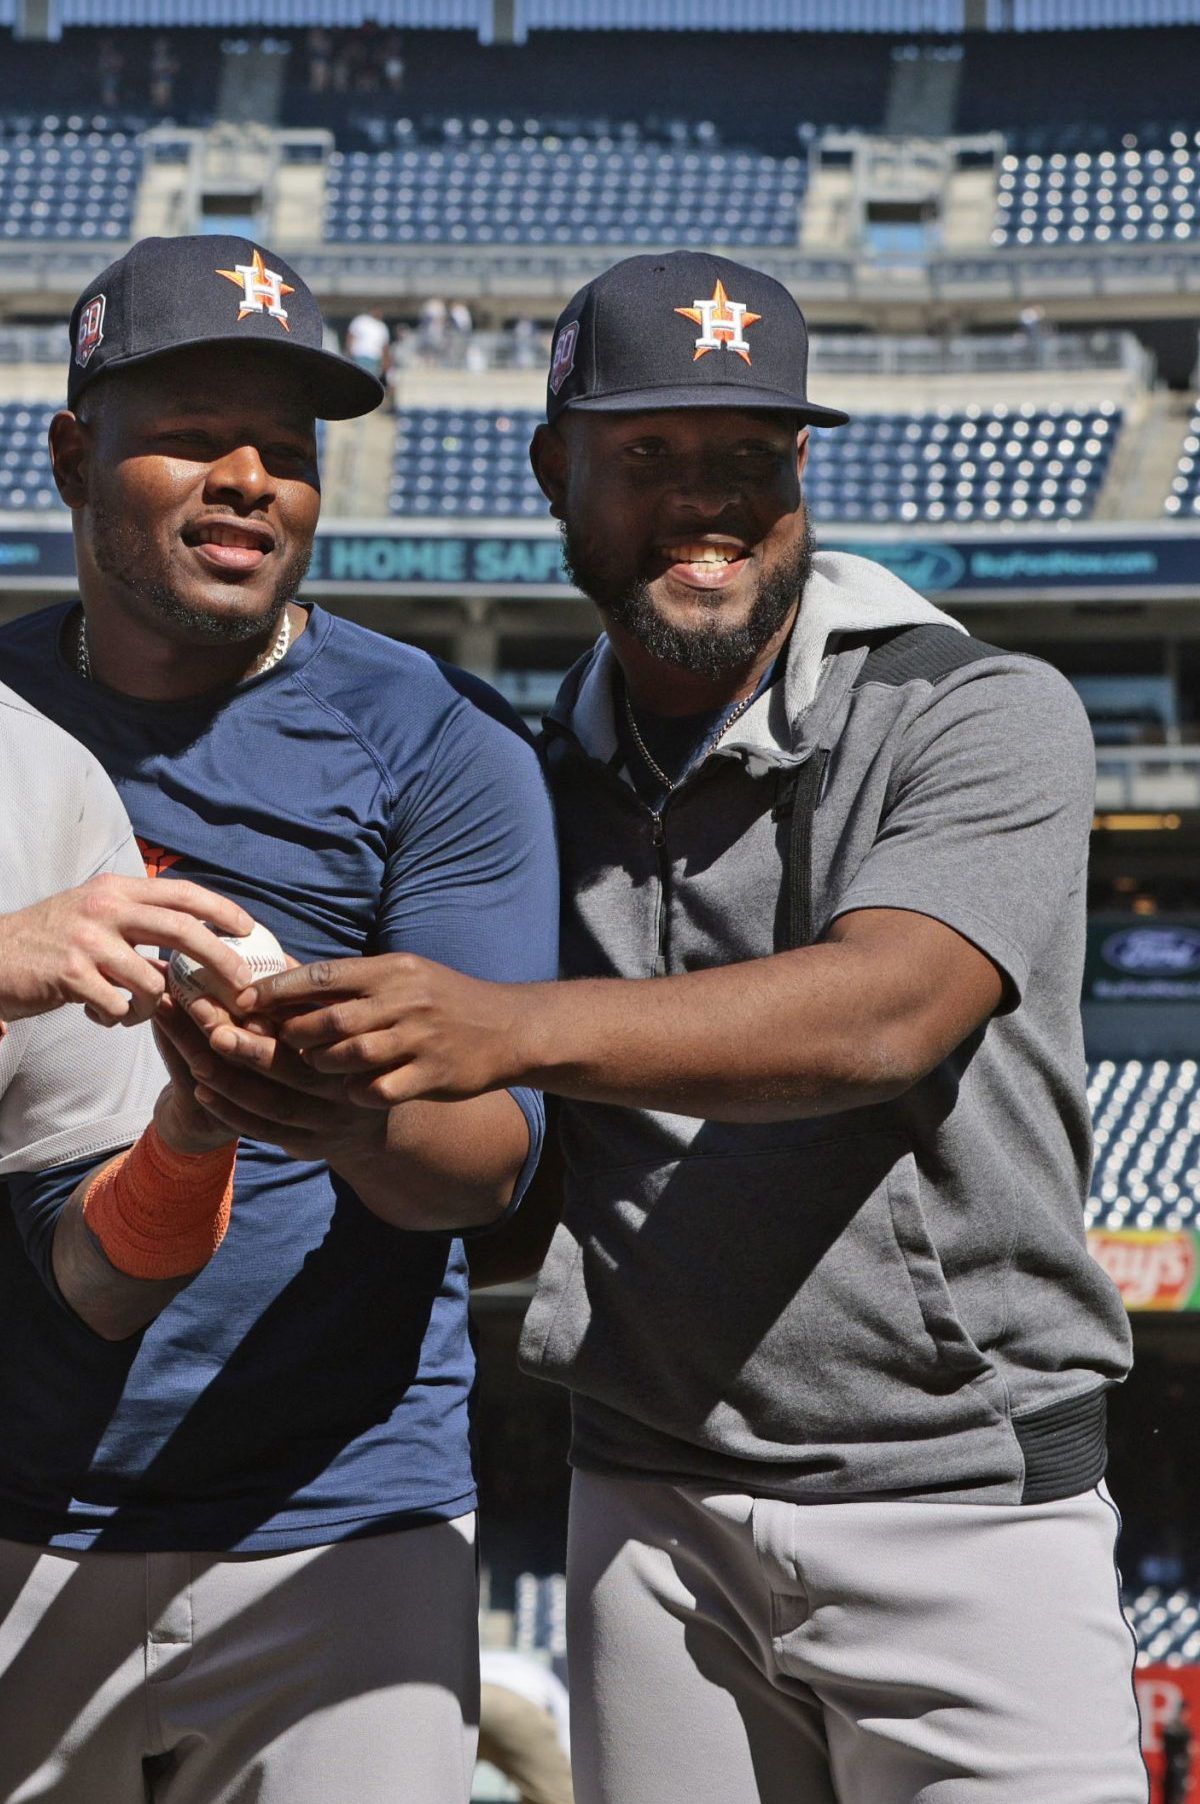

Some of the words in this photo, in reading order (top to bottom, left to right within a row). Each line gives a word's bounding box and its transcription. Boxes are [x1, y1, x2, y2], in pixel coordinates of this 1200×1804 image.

[235, 264, 288, 319] H
[693, 299, 750, 351] H
[330, 540, 466, 581] HOME
